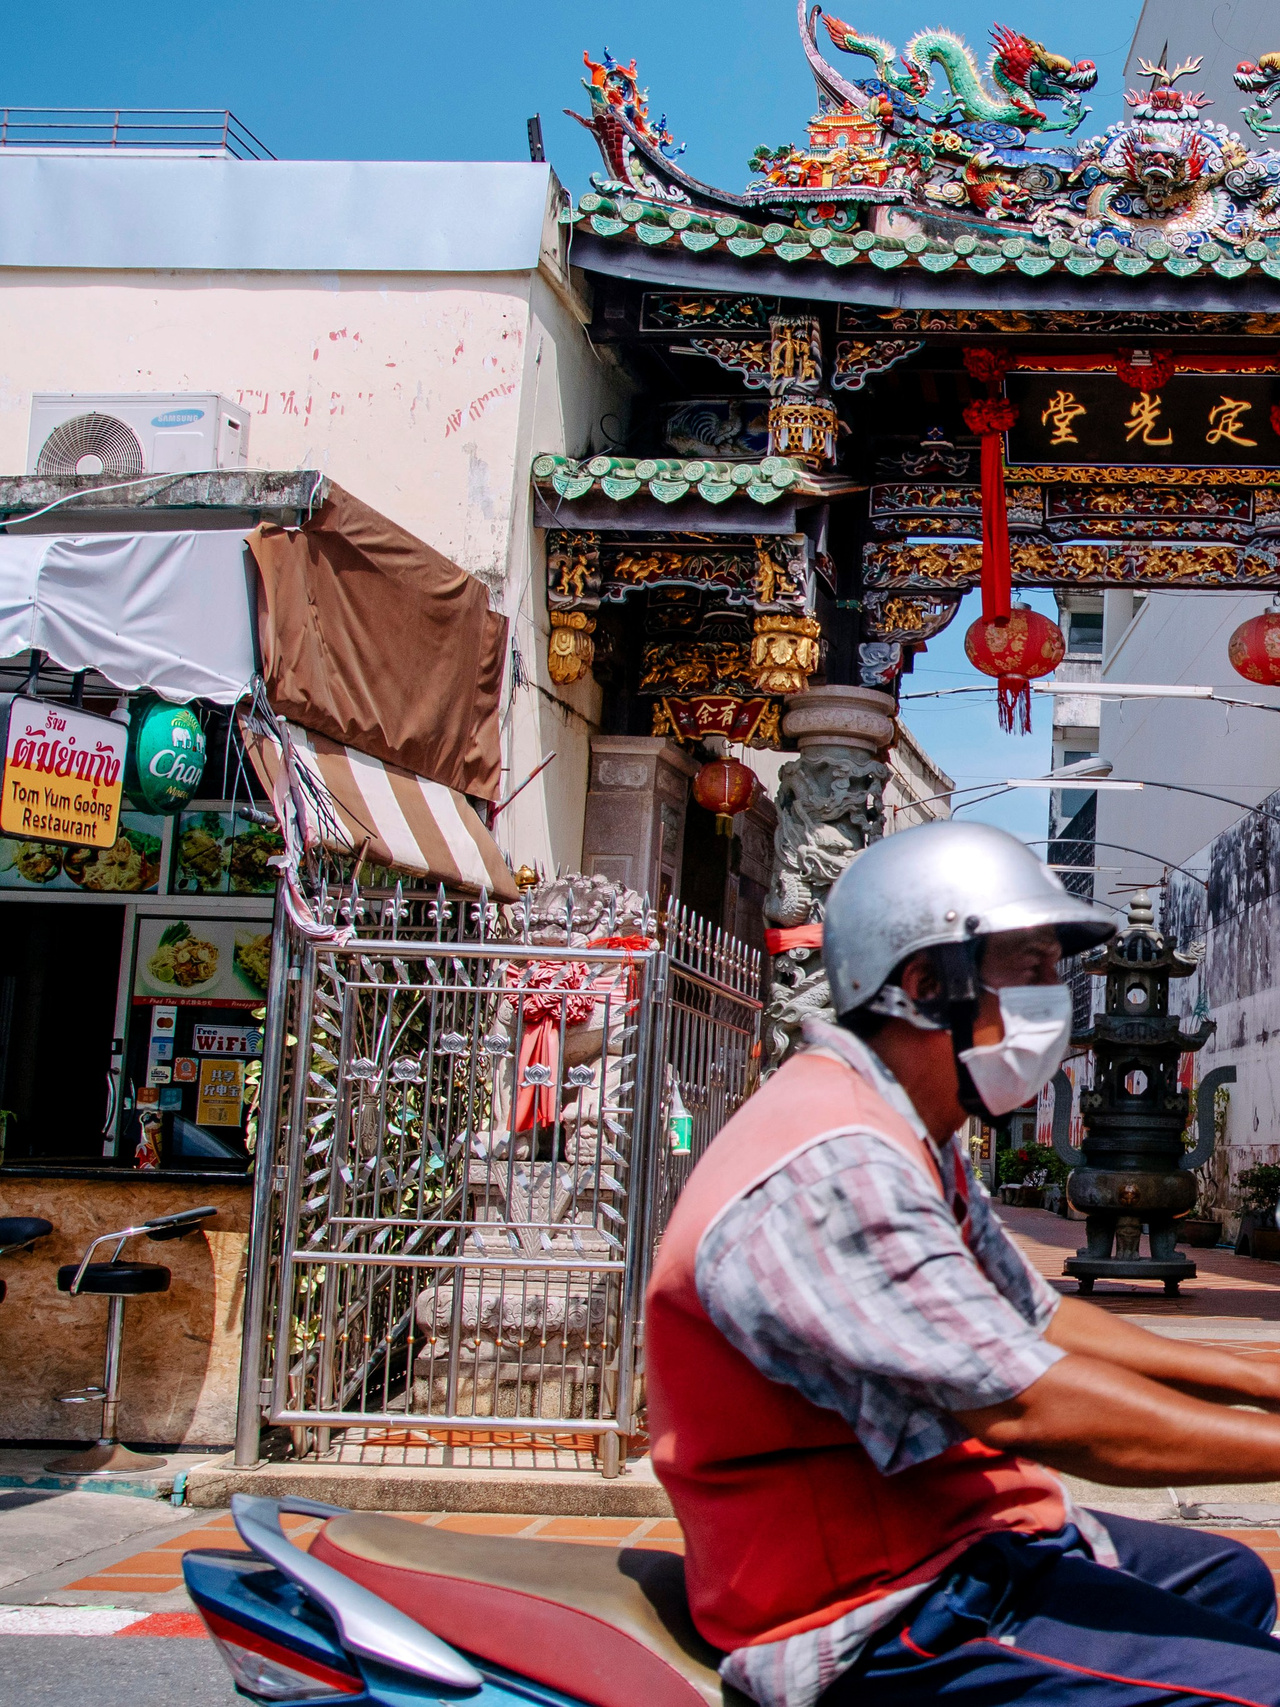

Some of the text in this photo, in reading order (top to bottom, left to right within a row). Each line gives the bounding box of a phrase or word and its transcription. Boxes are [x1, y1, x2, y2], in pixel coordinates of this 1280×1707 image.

[158, 414, 198, 423] SAMSUNG
[45, 711, 66, 733] ร้าน
[10, 725, 121, 800] ต้มยำกุ้ง
[149, 749, 203, 786] Chan
[12, 780, 112, 821] Tom Yum Goong
[22, 807, 97, 838] Restaurant
[197, 1028, 218, 1036] Free
[197, 1035, 247, 1052] WiFi
[211, 1069, 236, 1083] 共享
[203, 1084, 241, 1098] 充电宝
